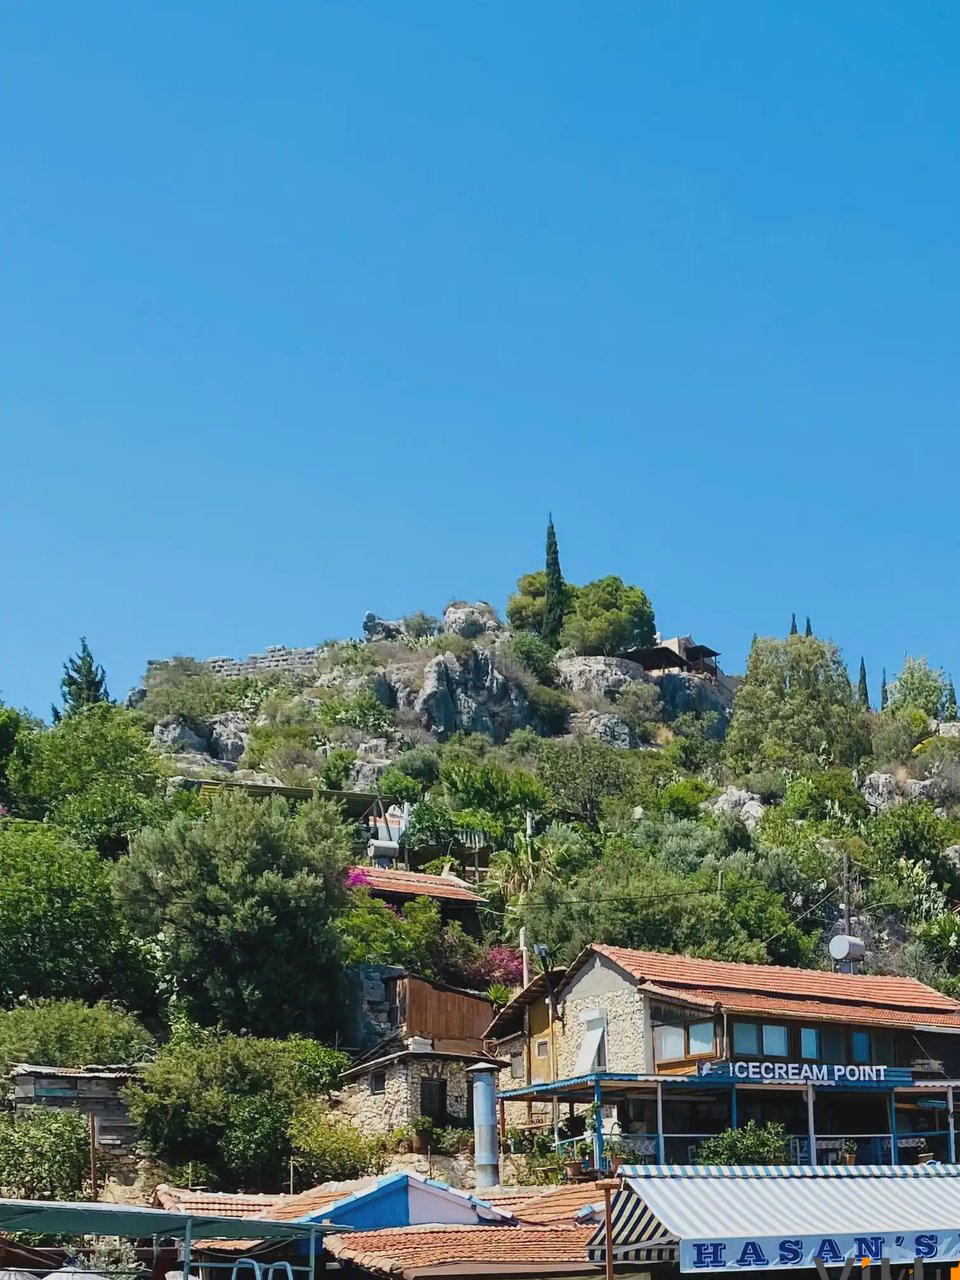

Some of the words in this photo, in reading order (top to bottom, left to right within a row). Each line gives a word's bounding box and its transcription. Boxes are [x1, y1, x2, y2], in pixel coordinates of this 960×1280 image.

[729, 1061, 827, 1081] ICECREAM
[834, 1065, 887, 1081] POINT
[692, 1234, 939, 1268] HASAN'S
